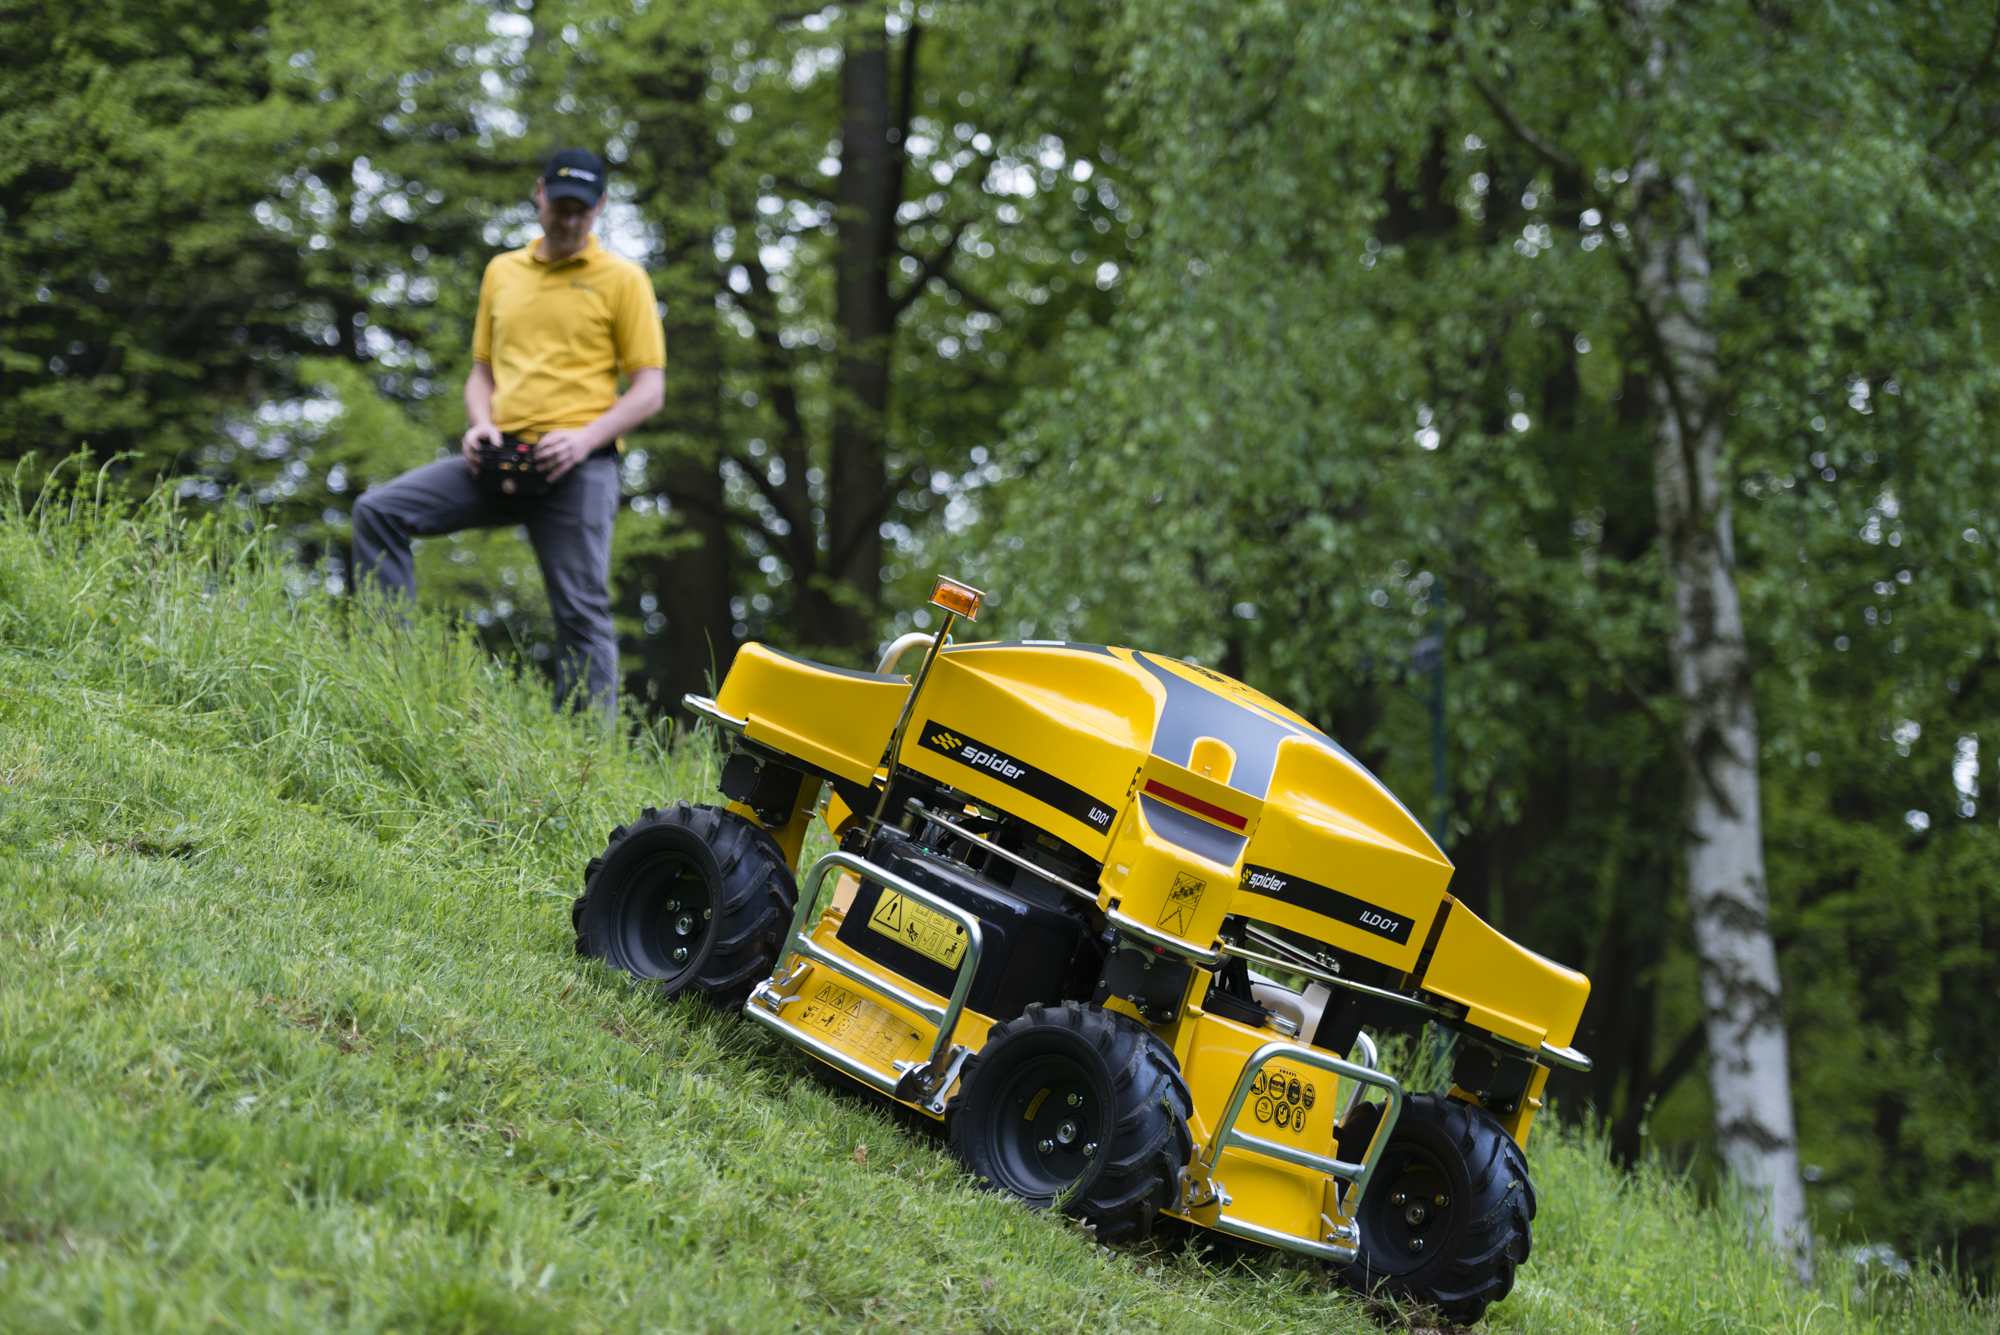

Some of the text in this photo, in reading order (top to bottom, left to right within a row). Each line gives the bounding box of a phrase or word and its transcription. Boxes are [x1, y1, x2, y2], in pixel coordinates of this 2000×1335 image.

[961, 745, 1110, 826] spider ILD01
[1248, 872, 1400, 933] spider ILD01
[1279, 1068, 1297, 1078] AWARDS
